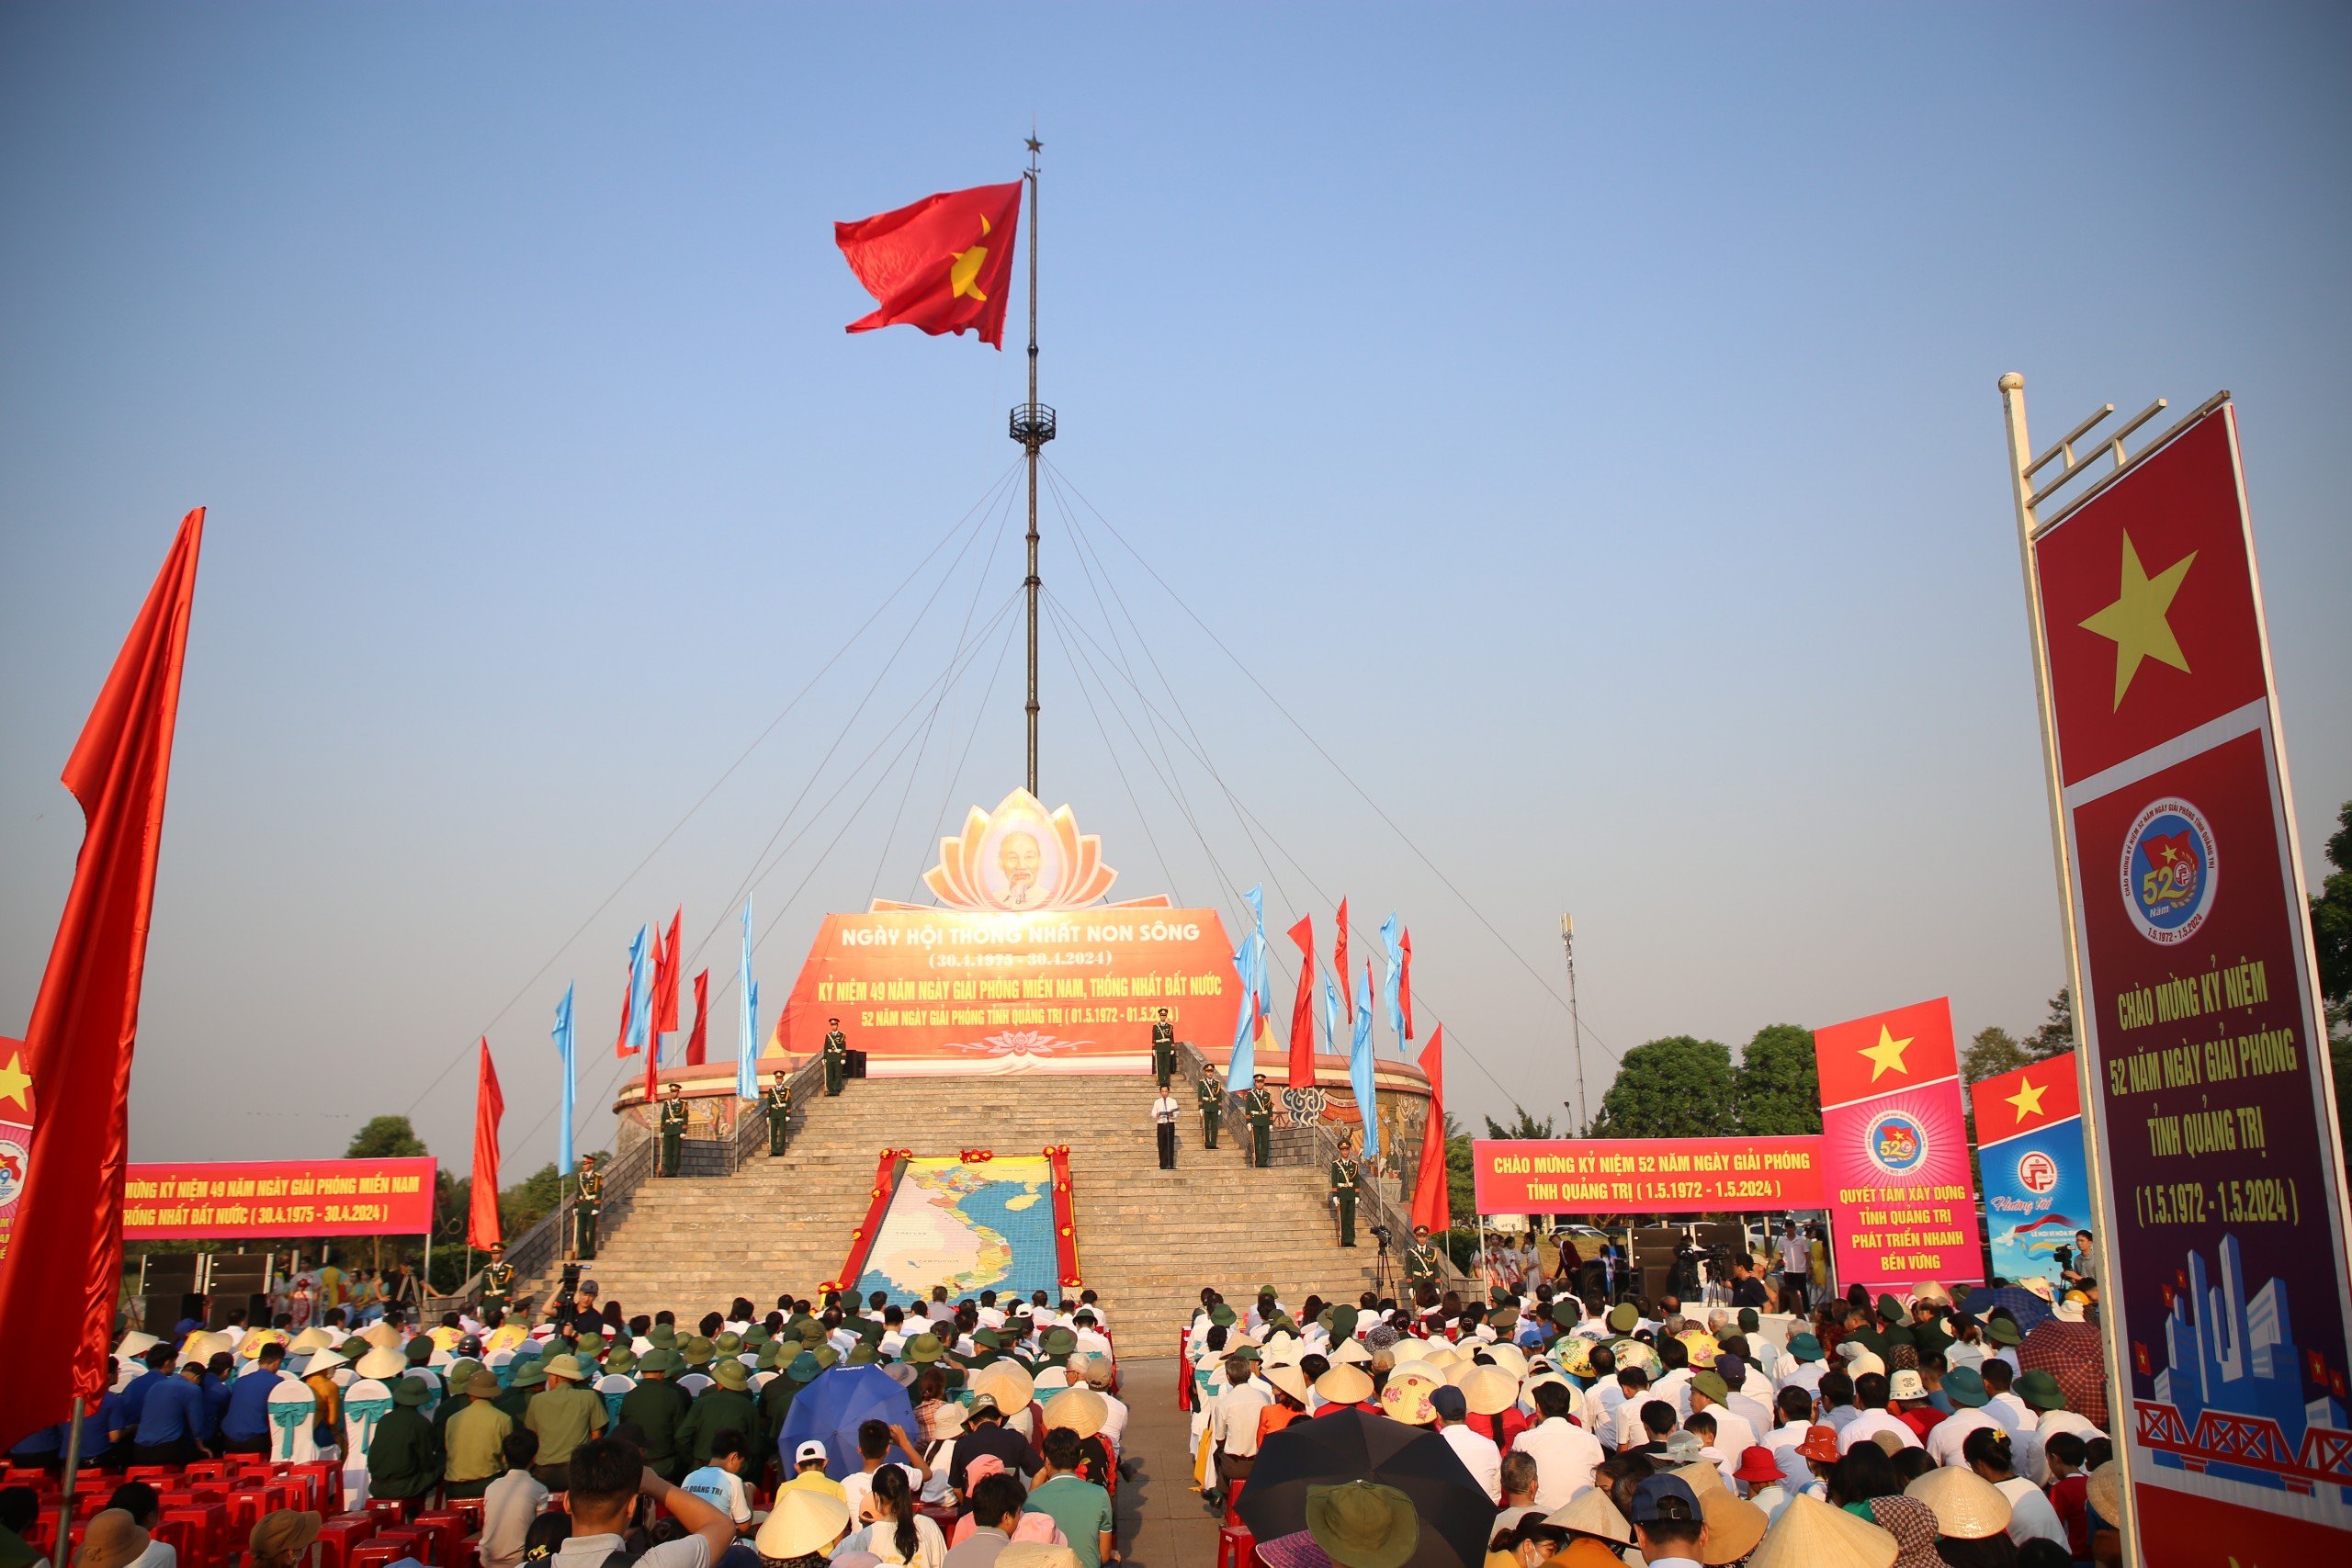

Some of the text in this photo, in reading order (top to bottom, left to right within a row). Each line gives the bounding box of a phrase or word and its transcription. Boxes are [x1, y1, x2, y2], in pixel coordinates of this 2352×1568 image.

[2143, 866, 2188, 907] 52
[842, 925, 900, 946] NGÀY
[906, 924, 943, 951] HỘI
[1028, 919, 1081, 943] NHẤT
[1087, 924, 1134, 942] NON
[1139, 920, 1201, 942] SÔNG
[2147, 927, 2174, 942] 1.5.1972
[2177, 913, 2203, 939] 1.5.2024
[818, 970, 1222, 1006] KỶ NIỆM 49 NĂM NGÀY GIẢI PHÓNG MIỀN NAM, THỐNG NHẤT ĐẤT NƯỚC
[2117, 953, 2268, 1031] CHÀO MỪNG KỶ NIỆM
[861, 1010, 874, 1027] 52
[876, 1008, 899, 1027] NĂM
[900, 1007, 928, 1026] NGÀY
[930, 1004, 949, 1026] GIẢI
[951, 1007, 985, 1025] PHÓNG
[987, 1003, 1010, 1025] TỈNH
[1012, 1003, 1045, 1026] QUẢNG
[1046, 1008, 1063, 1028] TRỊ
[1071, 1007, 1118, 1023] 01.5.1972
[1126, 1006, 1174, 1022] 01.5.204
[2109, 1021, 2298, 1097] 52 NĂM NGÀY GIẢI PHÓNG
[2147, 1094, 2267, 1158] TỈNH QUẢNG TRỊ
[1494, 1147, 1811, 1177] CHÀO MỪNG KỶ NIỆM 52 NĂM NGÀY GIẢI PHÓNG
[159, 1174, 177, 1199] KỶ
[176, 1178, 209, 1201] NIỆM
[209, 1180, 226, 1198] 49
[226, 1177, 255, 1198] NĂM
[256, 1176, 289, 1197] NGÀY
[289, 1171, 316, 1196] GIẢI
[316, 1174, 357, 1195] PHÓNG
[358, 1171, 390, 1194] MIỀN
[390, 1175, 420, 1193] NAM
[1526, 1177, 1558, 1201] TỈNH
[1561, 1176, 1609, 1202] QUẢNG
[1611, 1182, 1634, 1203] TRỊ
[1645, 1181, 1703, 1199] 1.5.1972
[1714, 1179, 1773, 1198] 1.5.2024
[1839, 1183, 1966, 1205] QUYẾT TÂM XÂY DỰNG
[2144, 1182, 2207, 1224] 1.5.1972
[2217, 1178, 2288, 1224] 1.5.2024
[157, 1202, 190, 1226] NHẤT
[190, 1201, 215, 1225] ĐẤT
[215, 1202, 248, 1225] NƯỚC
[257, 1205, 315, 1224] 30.4.1975
[323, 1204, 381, 1223] 30.4.2024
[1859, 1203, 1952, 1226] TỈNH QUẢNG TRỊ
[1851, 1226, 1964, 1249] PHÁT TRIỂN NHANH
[1881, 1250, 1941, 1271] BỀN VỮNG
